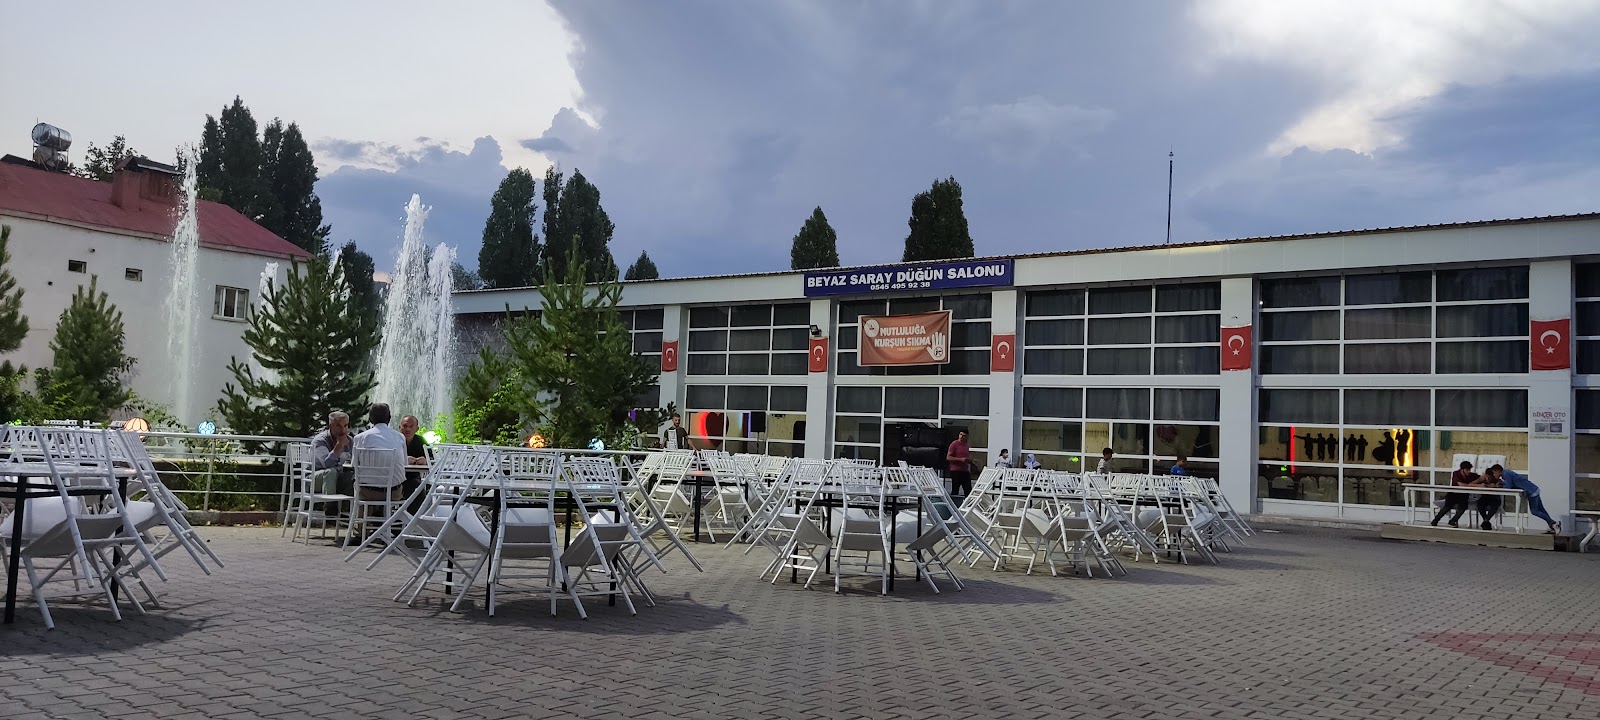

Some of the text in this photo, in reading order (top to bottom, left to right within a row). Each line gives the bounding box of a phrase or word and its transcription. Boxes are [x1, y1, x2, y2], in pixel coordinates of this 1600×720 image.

[807, 265, 1005, 287] BEYAZ SARAY DÜĞÜN SALONU
[880, 324, 926, 336] MUTLULUĞA
[874, 336, 931, 348] KURŞUN SIKMA
